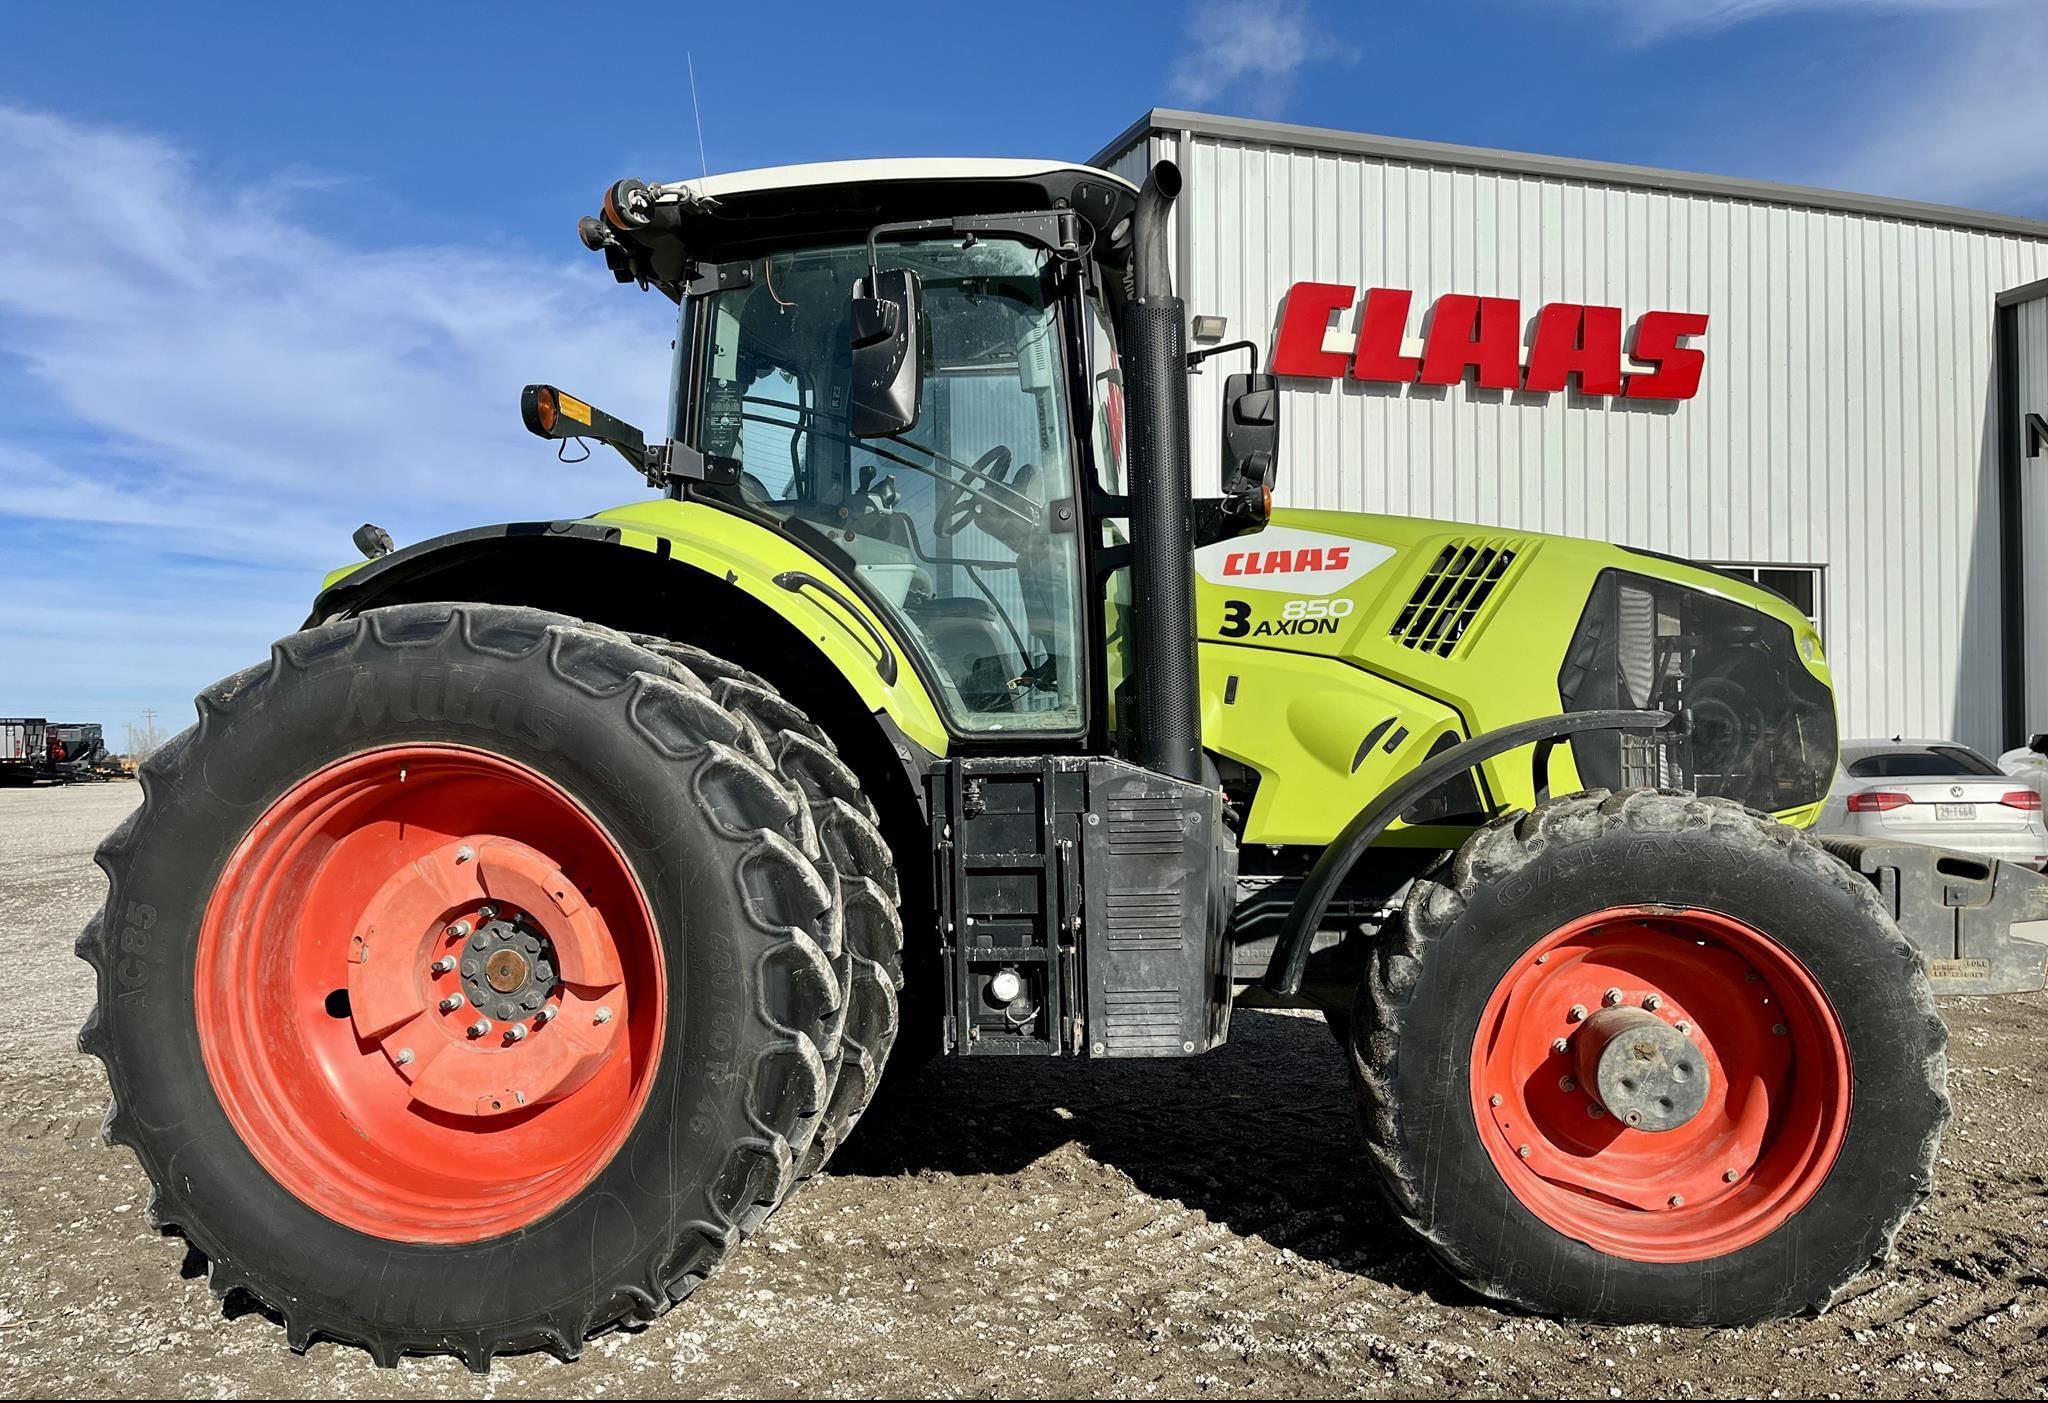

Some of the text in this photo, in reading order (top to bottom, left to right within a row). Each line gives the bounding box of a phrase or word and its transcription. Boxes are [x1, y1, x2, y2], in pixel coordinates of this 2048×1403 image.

[1271, 281, 1709, 400] CLAAS
[1222, 546, 1350, 577] CLAAS
[1219, 600, 1252, 638] 3
[1282, 598, 1354, 620] 850
[1252, 618, 1340, 637] AXION
